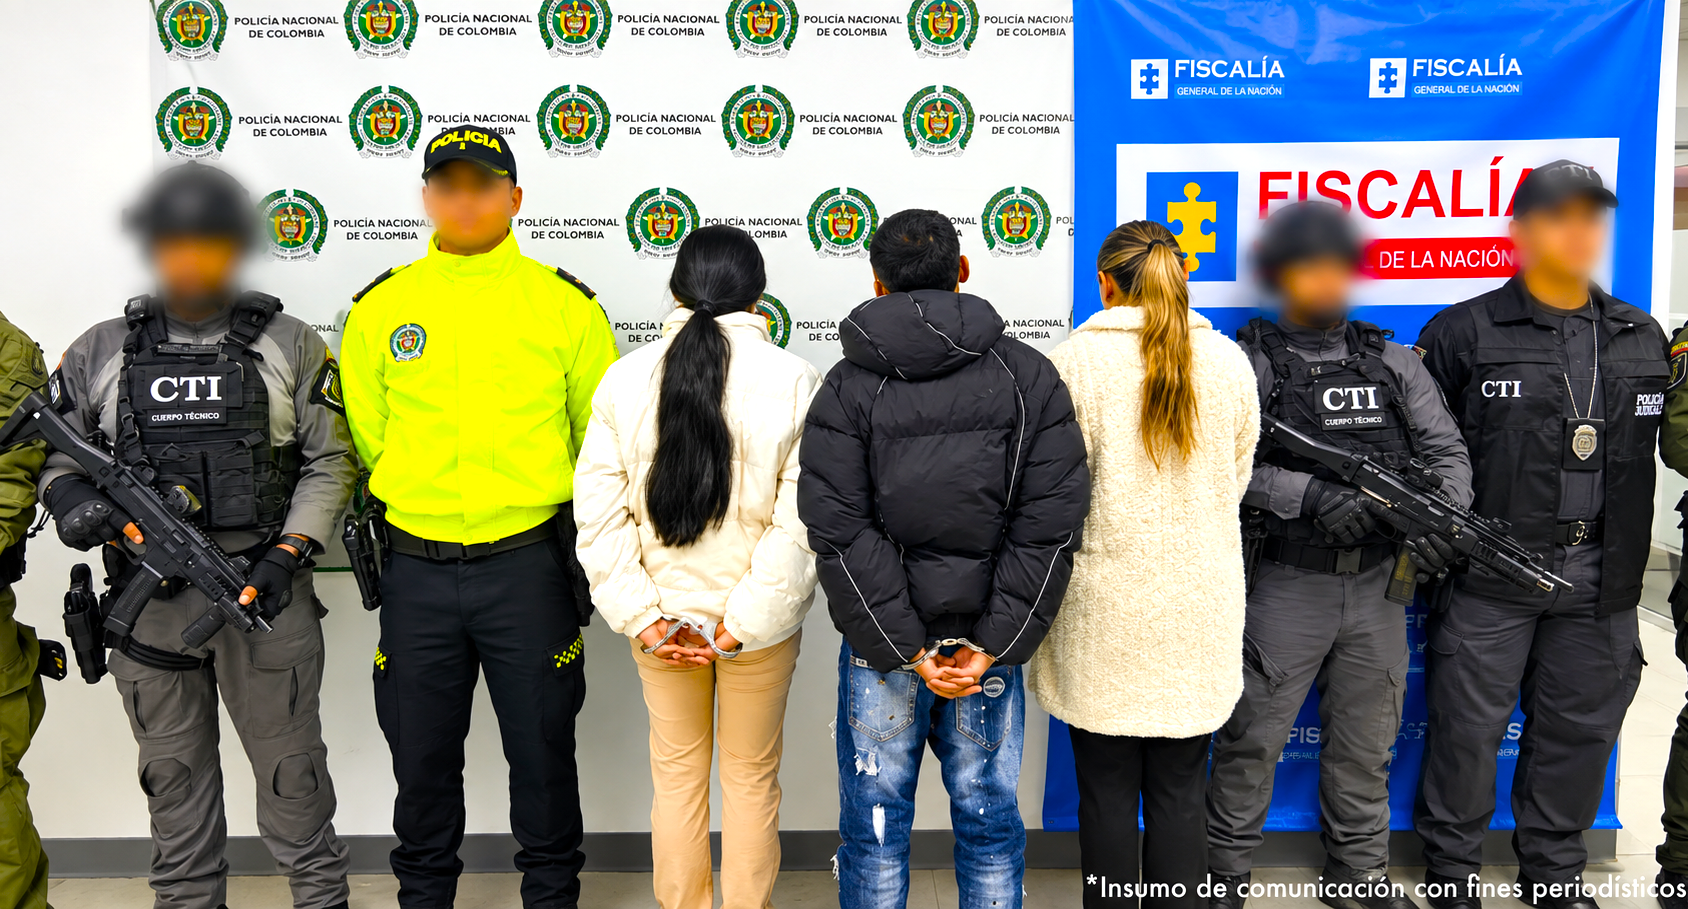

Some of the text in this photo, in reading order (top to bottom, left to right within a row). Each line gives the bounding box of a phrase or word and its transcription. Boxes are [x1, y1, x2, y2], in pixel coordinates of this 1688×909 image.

[234, 14, 339, 26] POLICÍA NACIONAL
[424, 12, 533, 24] POLICÍA NACIONAL
[617, 12, 720, 24] POLICÍA NACIONAL
[803, 13, 903, 24] POLICÍA NACIONAL
[984, 13, 1025, 24] POLICÍA
[248, 29, 325, 39] DE COLOMBIA
[439, 26, 517, 36] DE COLOMBIA
[631, 27, 705, 37] DE COLOMBIA
[816, 27, 888, 37] DE COLOMBIA
[996, 27, 1067, 37] DE COLOMBIA
[1175, 56, 1284, 77] FISCALÍA
[1413, 54, 1522, 76] FISCALÍA
[1177, 84, 1282, 95] GENERAL DE LA NACIÓN
[1414, 83, 1519, 94] GENERAL DE LA NACIÓN
[238, 113, 343, 125] POLICÍA NACIONAL
[427, 112, 531, 124] POLICÍA NACIONAL
[615, 112, 717, 123] POLICÍA NACIONAL
[799, 112, 898, 123] POLICÍA NACIONAL
[979, 112, 1020, 123] POLICÍA
[252, 127, 328, 137] DE COLOMBIA
[629, 126, 702, 136] DE COLOMBIA
[812, 126, 883, 136] DE COLOMBIA
[991, 125, 1061, 135] DE COLOMBIA
[430, 130, 502, 153] POLICIA
[333, 217, 376, 228] POLICÍA
[517, 216, 620, 227] POLICÍA NACIONAL
[705, 216, 802, 226] POLICÍA NACIONAL
[950, 217, 977, 225] ONAL
[346, 231, 419, 241] DE COLOMBIA
[531, 230, 605, 240] DE COLOMBIA
[749, 230, 787, 239] LOMBIA
[1380, 250, 1406, 269] DE
[1411, 249, 1434, 268] LA
[615, 320, 657, 330] POLICÍA
[796, 319, 837, 329] POLICÍA
[1013, 319, 1064, 327] NACIONAL
[628, 334, 642, 342] DE
[809, 333, 822, 341] DE
[150, 376, 222, 402] CTI
[1481, 380, 1521, 397] CTI
[1322, 386, 1379, 411] CTI
